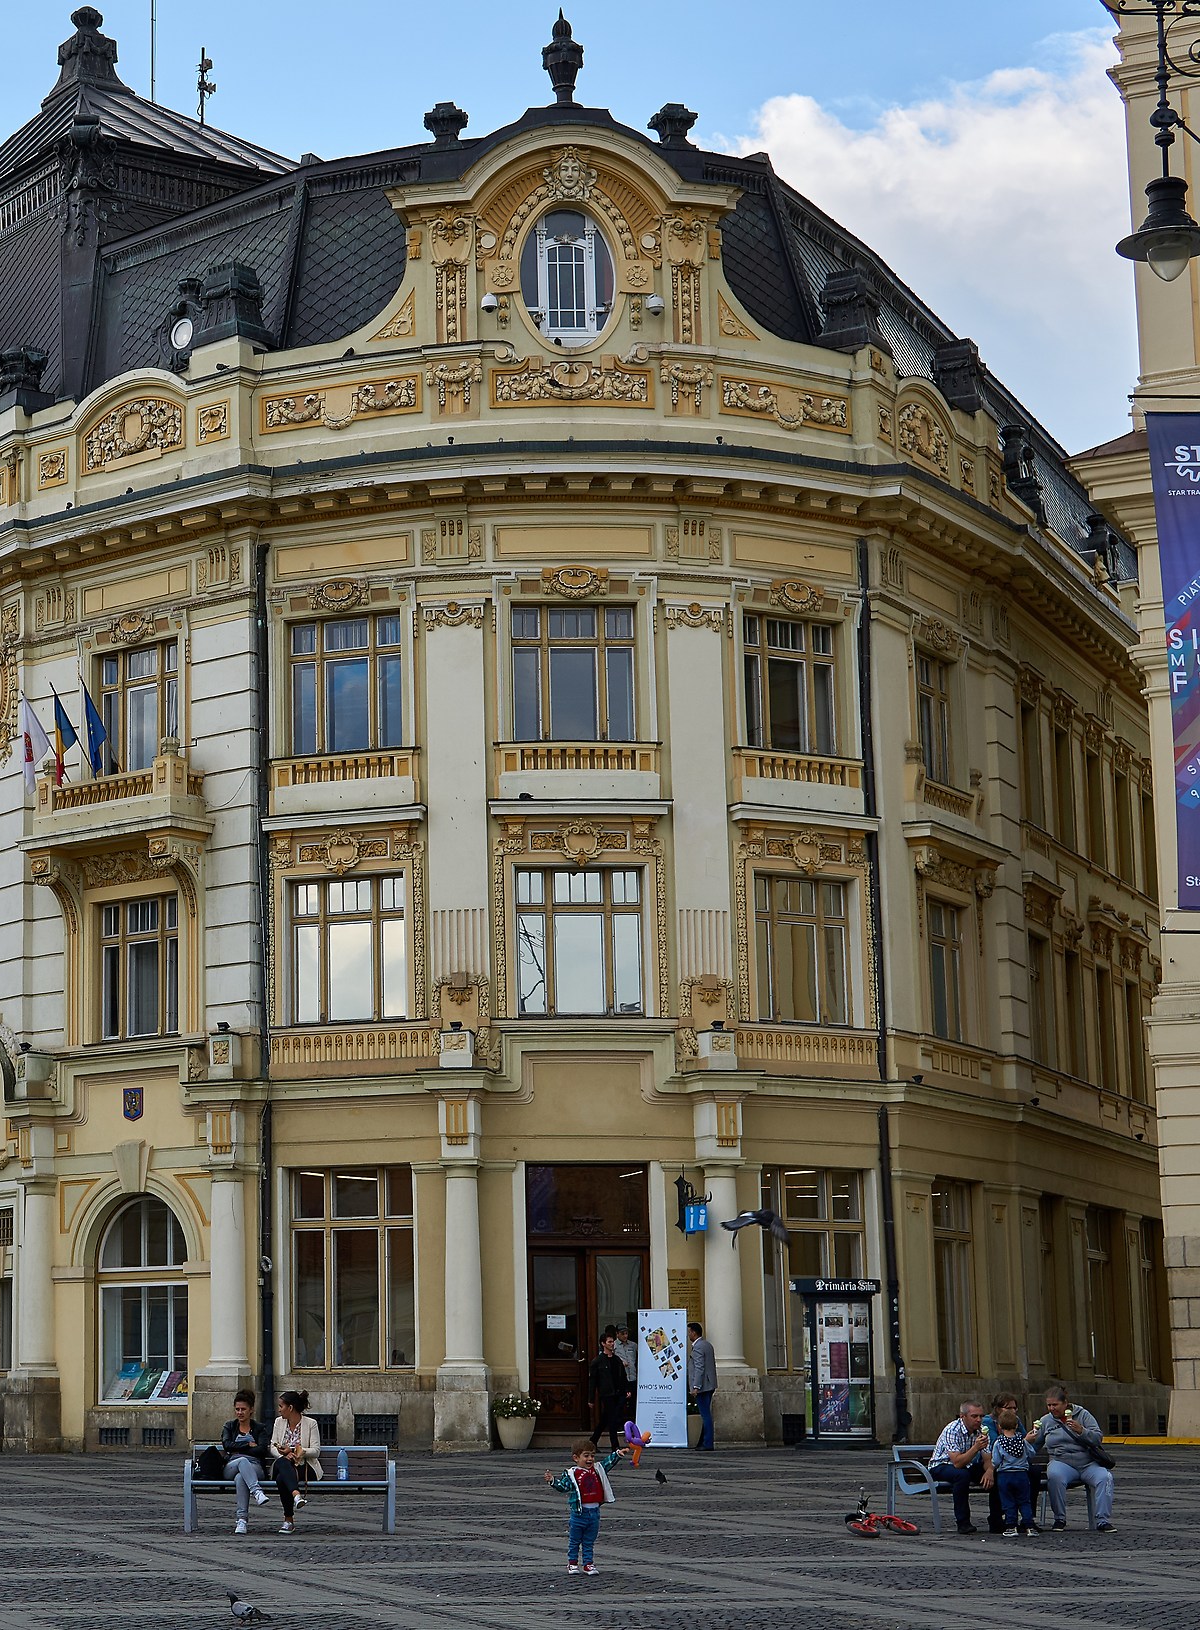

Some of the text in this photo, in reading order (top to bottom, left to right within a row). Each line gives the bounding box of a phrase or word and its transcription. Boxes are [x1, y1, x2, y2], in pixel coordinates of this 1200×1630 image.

[1177, 575, 1200, 606] PIAT
[1169, 628, 1198, 650] SI
[1185, 875, 1200, 887] St
